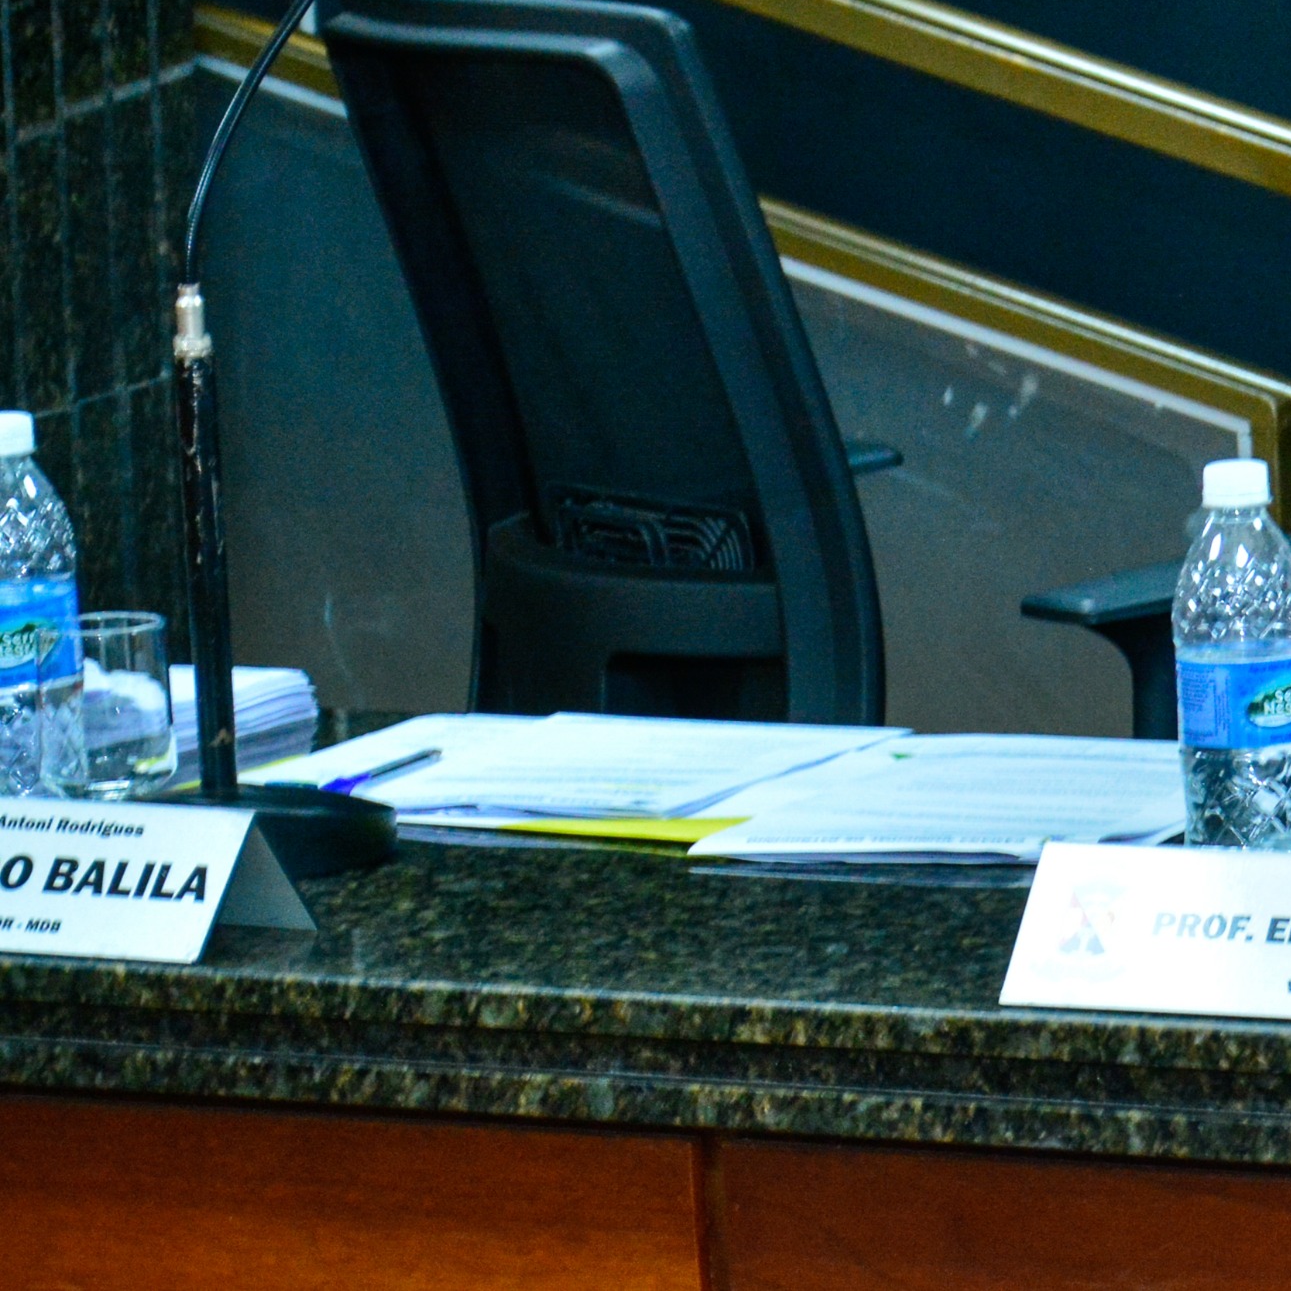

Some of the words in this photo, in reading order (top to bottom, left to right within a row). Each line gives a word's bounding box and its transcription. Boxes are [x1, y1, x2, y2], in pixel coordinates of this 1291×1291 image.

[56, 817, 145, 838] Rodrigues
[42, 857, 208, 903] BALILA
[25, 917, 62, 934] MDB
[1152, 910, 1254, 943] PROF.
